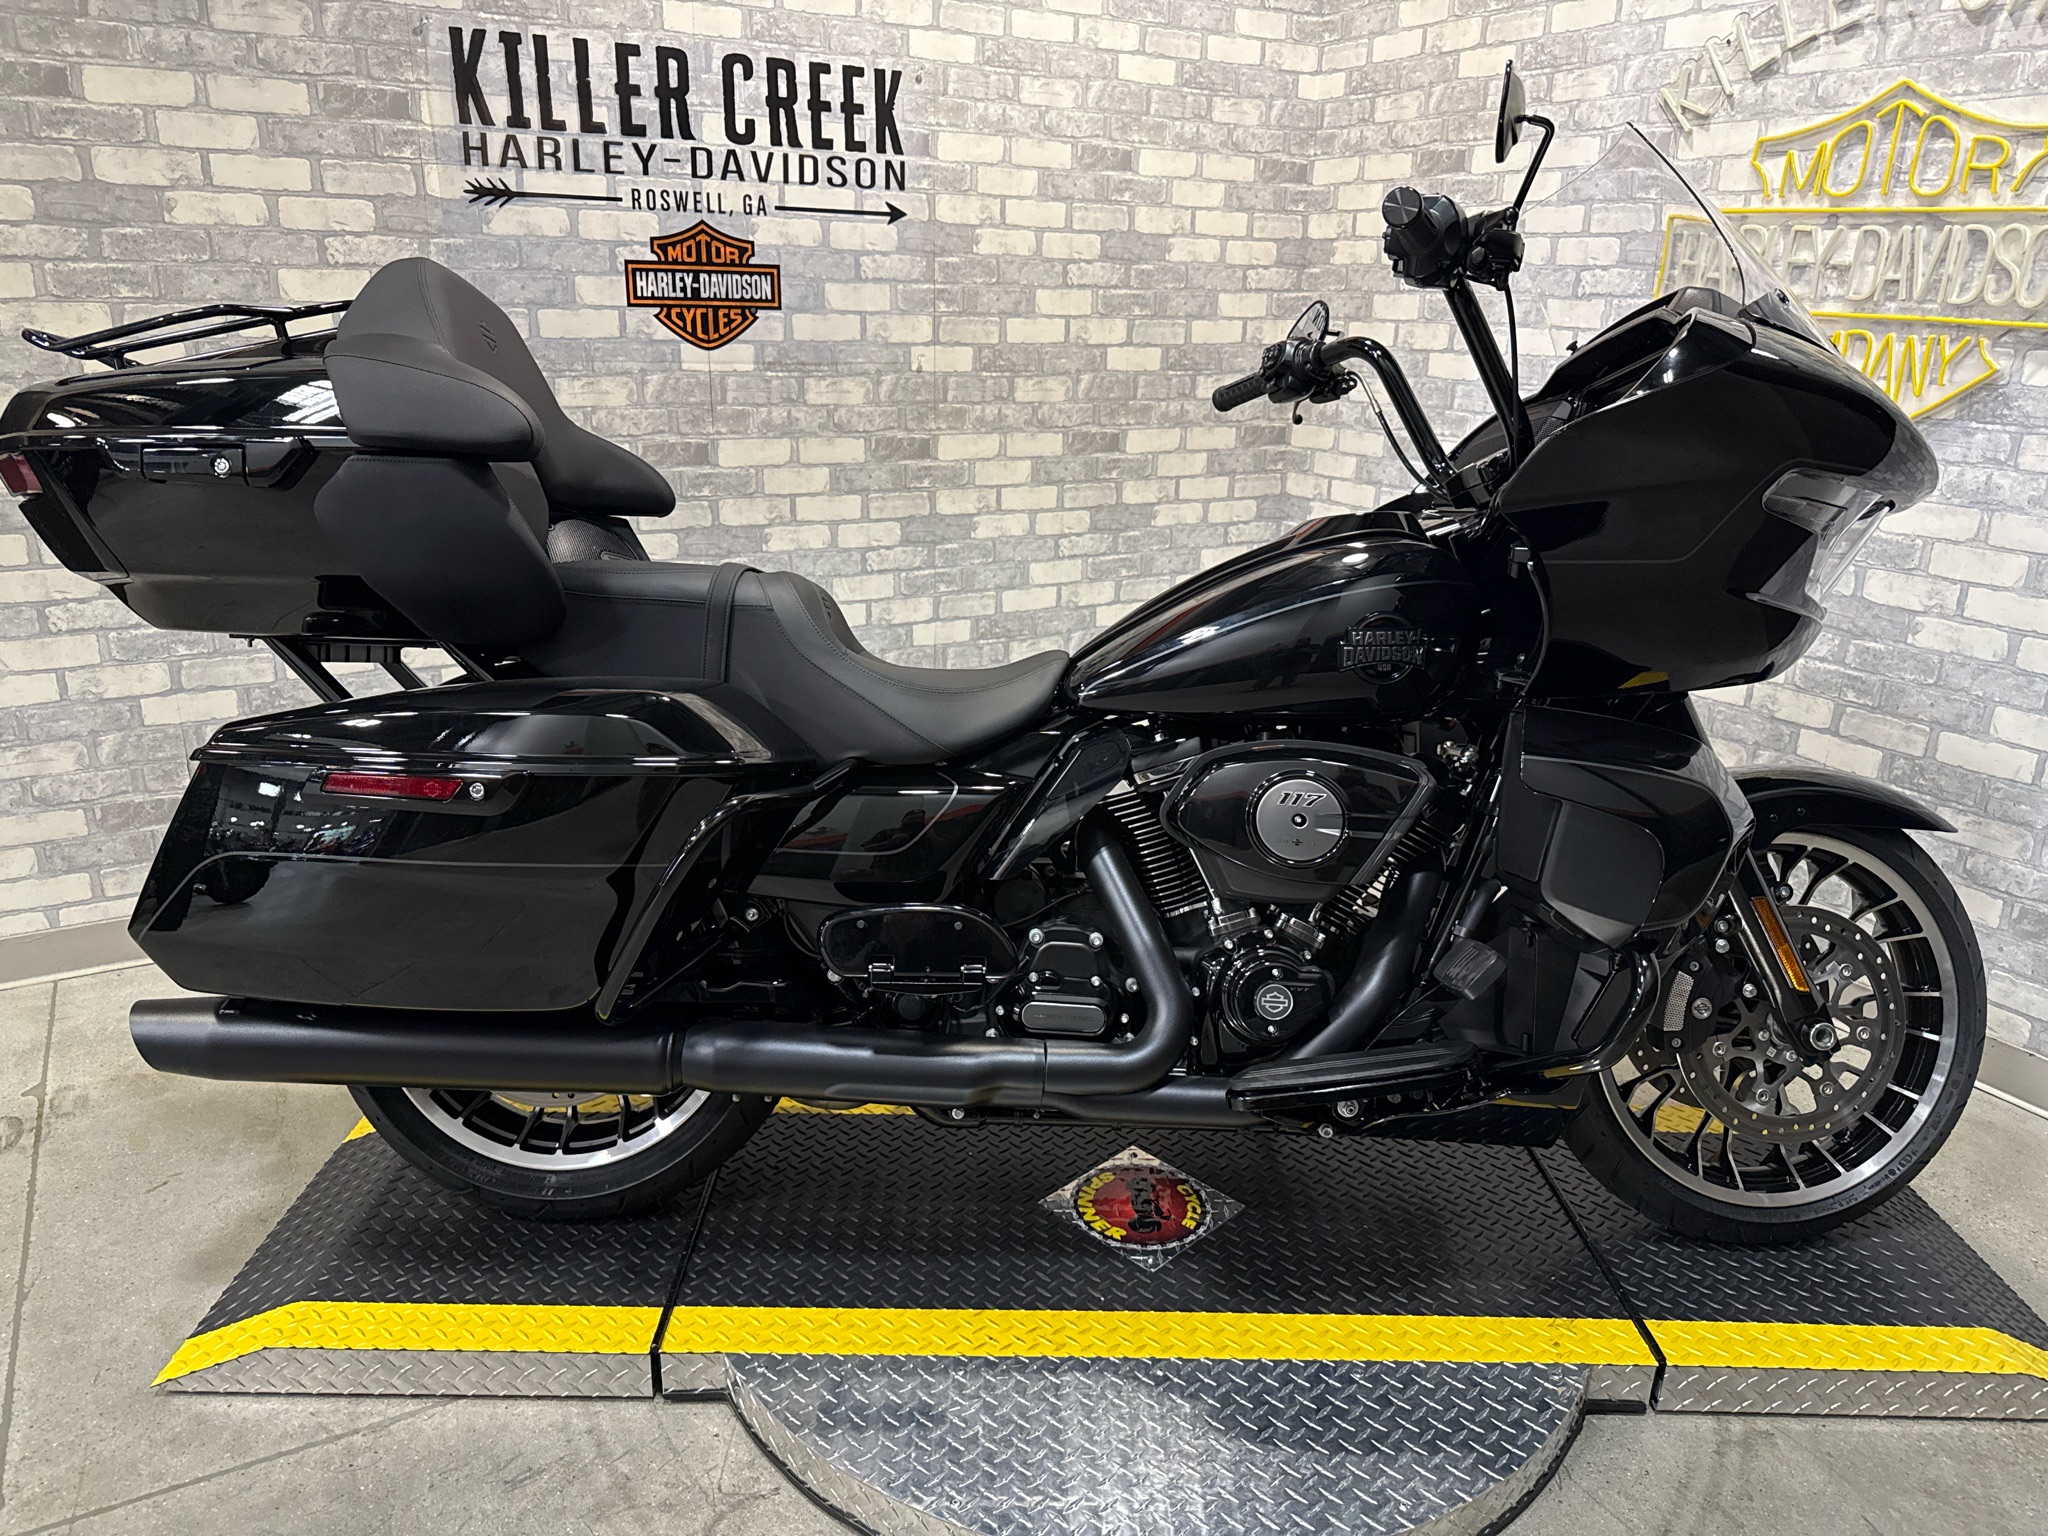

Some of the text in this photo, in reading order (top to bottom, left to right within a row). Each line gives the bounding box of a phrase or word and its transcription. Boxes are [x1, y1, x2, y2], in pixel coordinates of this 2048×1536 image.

[448, 26, 904, 155] KILLER CREEK
[462, 131, 906, 191] HARLEY-DAVIDSON
[1779, 99, 2011, 198] MOTOR
[631, 188, 768, 217] ROSWELL, GA
[667, 233, 739, 264] MOTOR
[636, 271, 772, 300] HARLEY-DAVIDSON
[671, 307, 742, 341] CYCLES
[1343, 646, 1424, 667] DAVIDSON
[1277, 791, 1327, 807] 117
[1077, 1172, 1127, 1240] SPINNER
[1177, 1184, 1202, 1230] CYCLE
